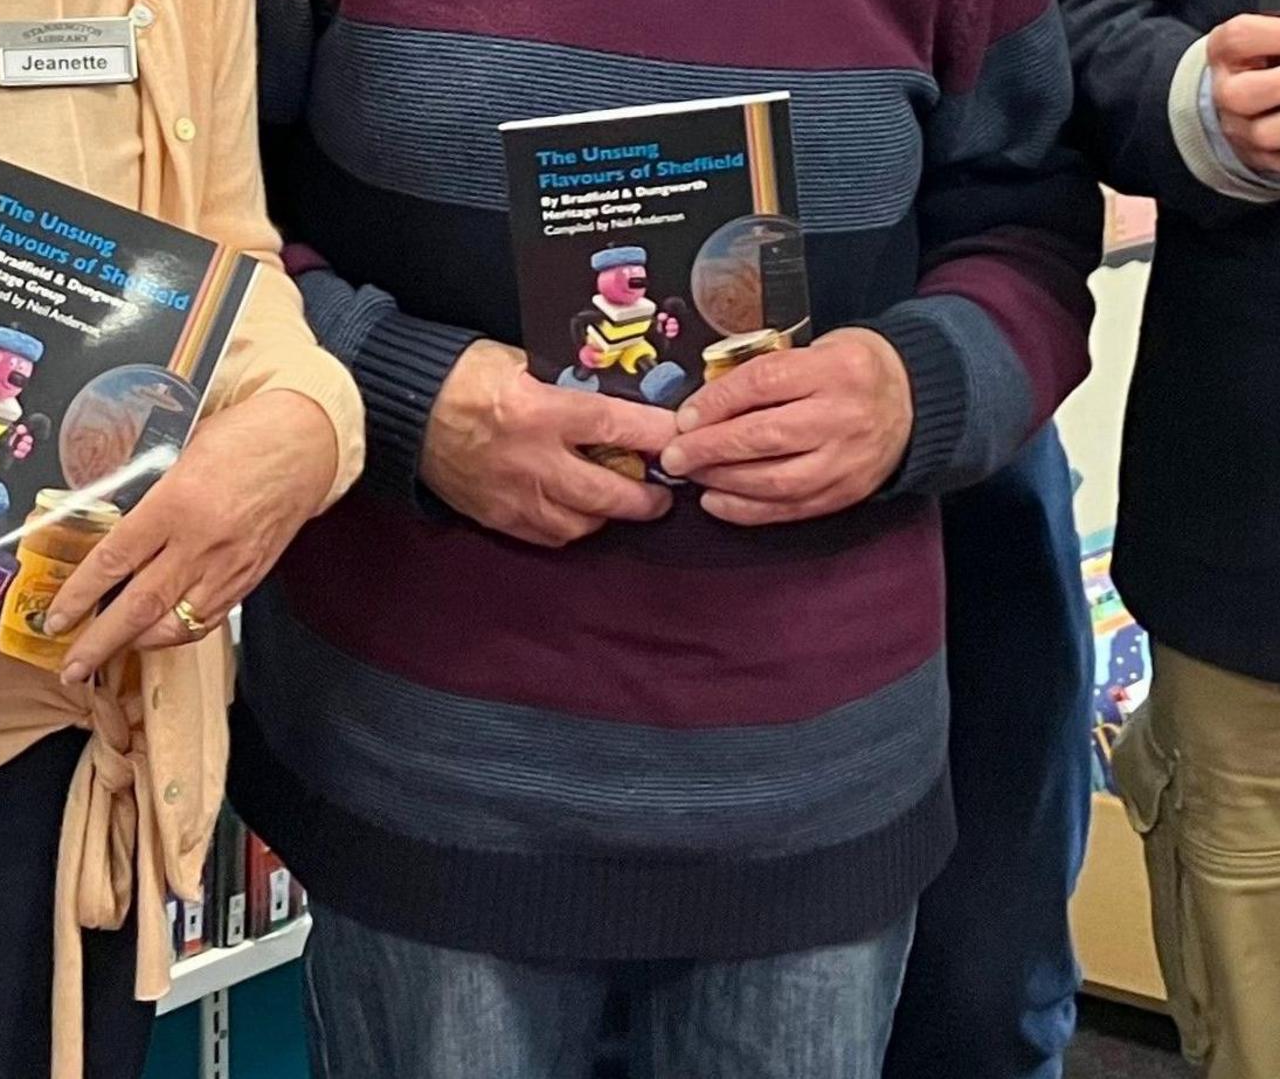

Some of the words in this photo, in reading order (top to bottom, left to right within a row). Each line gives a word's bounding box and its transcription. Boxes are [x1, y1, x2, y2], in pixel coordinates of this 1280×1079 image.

[21, 55, 108, 71] Jeanette
[536, 150, 576, 168] The
[581, 141, 660, 165] Unsung
[538, 164, 625, 190] Flavours
[629, 163, 652, 180] of
[656, 151, 746, 177] Sheffield
[540, 195, 558, 210] By
[634, 178, 709, 199] Dungworth
[541, 206, 599, 223] Heritage
[600, 202, 643, 217] Group
[632, 210, 686, 228] Anderson
[40, 211, 117, 258] Unsung
[72, 256, 98, 274] of
[25, 276, 68, 306] Group
[10, 292, 27, 310] by
[25, 298, 51, 318] Neil
